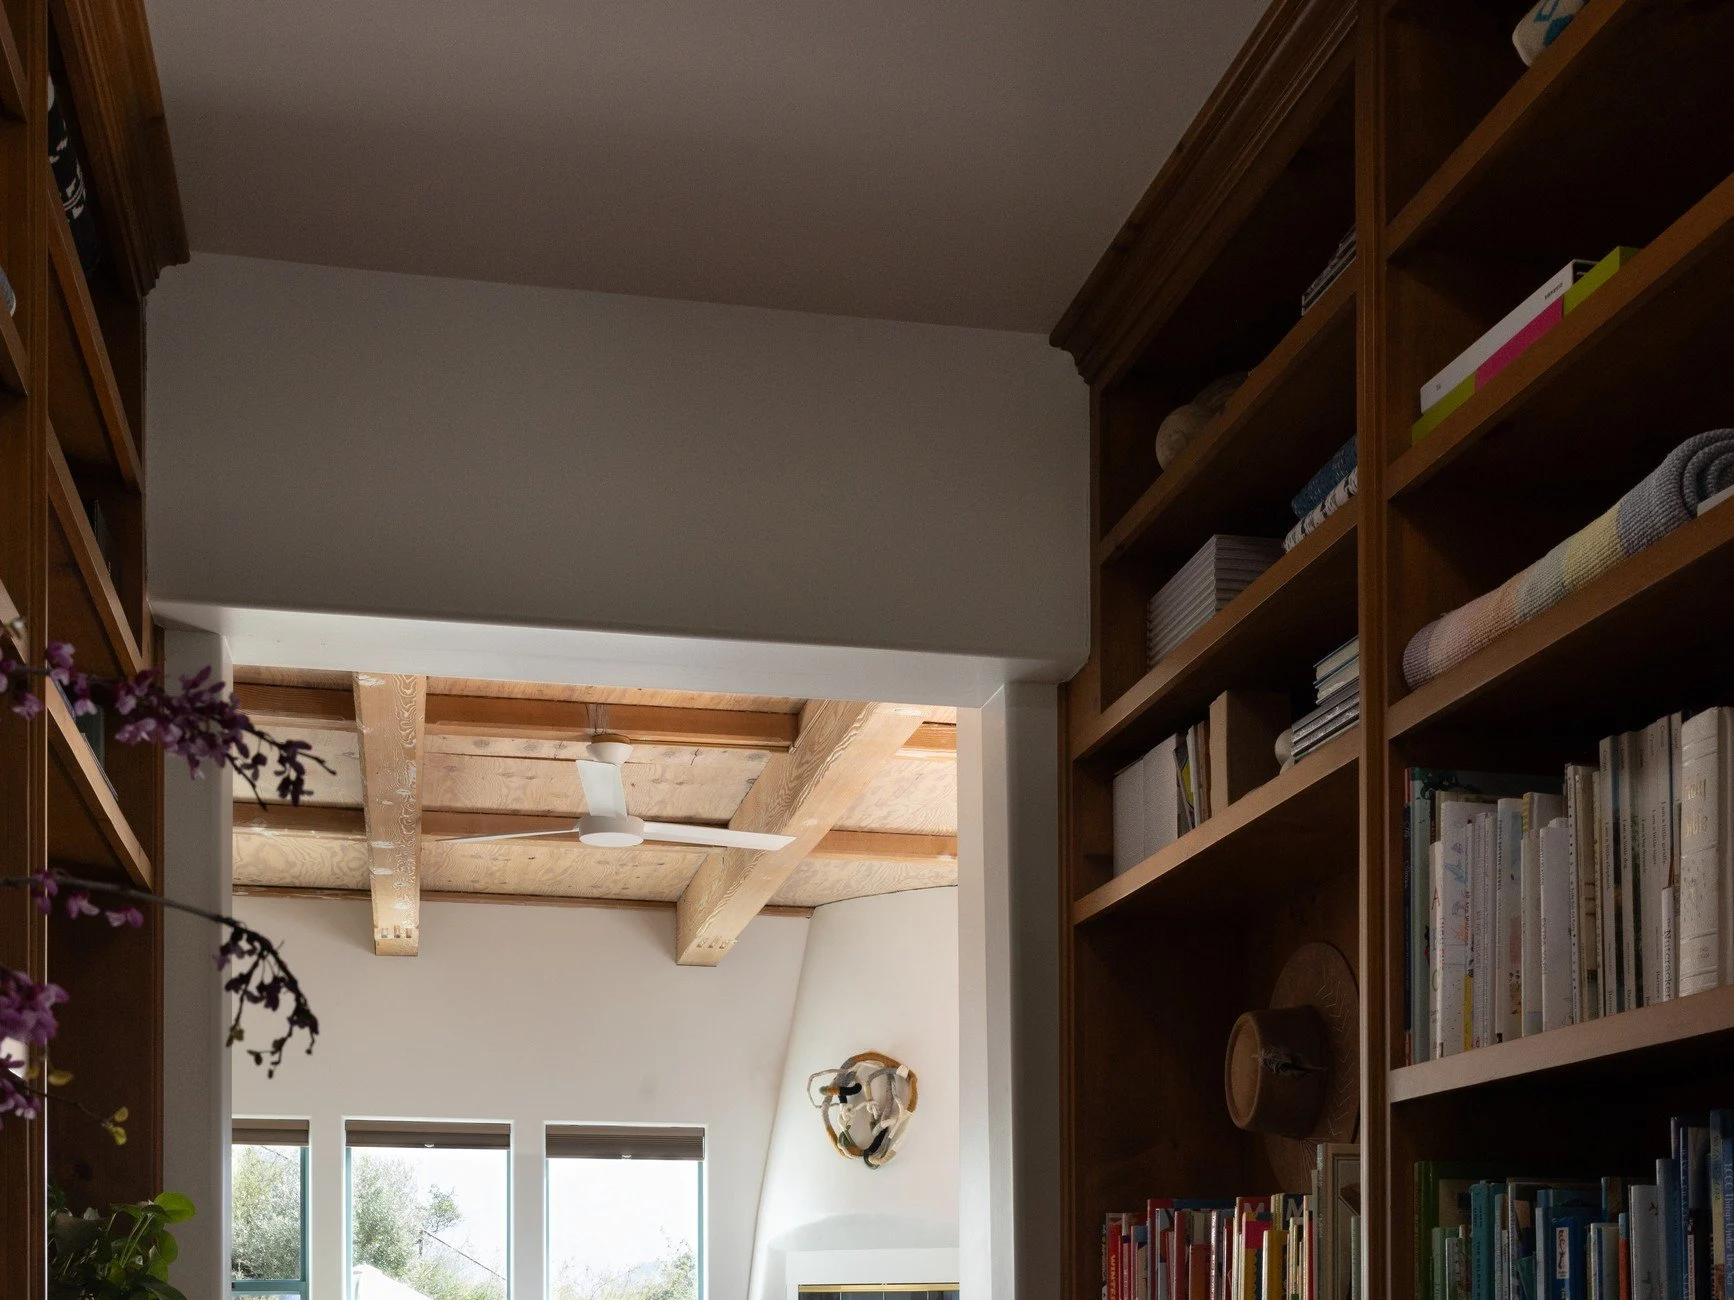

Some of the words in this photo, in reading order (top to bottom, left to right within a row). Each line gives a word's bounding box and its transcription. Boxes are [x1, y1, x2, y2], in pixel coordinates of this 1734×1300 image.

[1663, 929, 1672, 999] Nutcracker
[1724, 1193, 1734, 1221] Things
[1725, 1223, 1734, 1250] Under
[1726, 1253, 1734, 1267] the
